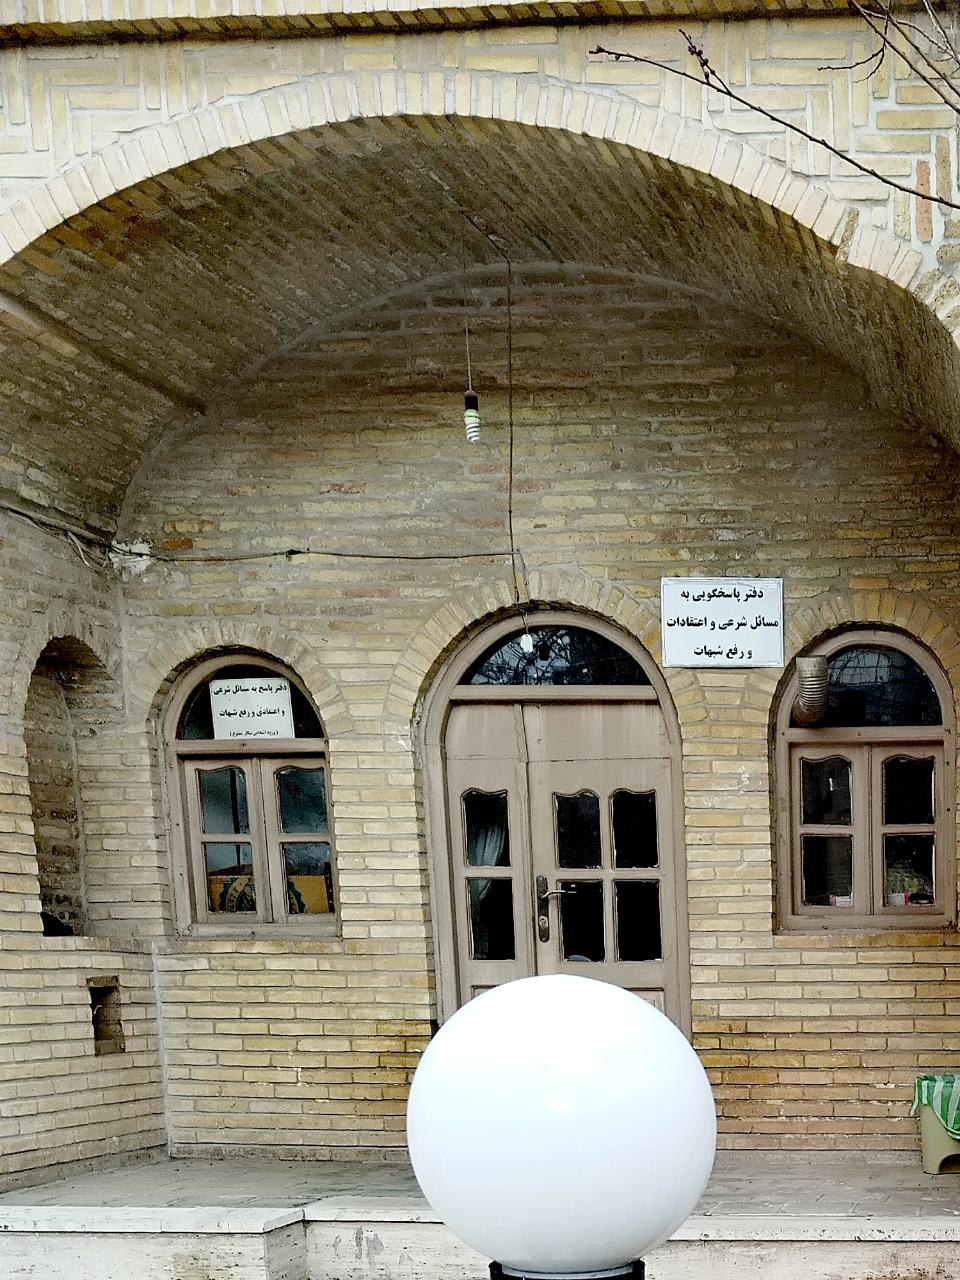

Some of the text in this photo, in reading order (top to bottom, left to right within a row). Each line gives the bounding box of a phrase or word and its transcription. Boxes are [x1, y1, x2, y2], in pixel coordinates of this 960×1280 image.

[680, 589, 690, 602] به
[743, 586, 764, 602] دفتر
[666, 614, 779, 630] مسائل شرعی و اعتقادات
[693, 644, 753, 659] و رفع شبهات
[213, 685, 231, 695] شرعی
[258, 684, 273, 694] پاسخ
[274, 684, 287, 694] دفتر
[219, 708, 238, 718] شبهات
[238, 709, 251, 718] رفع
